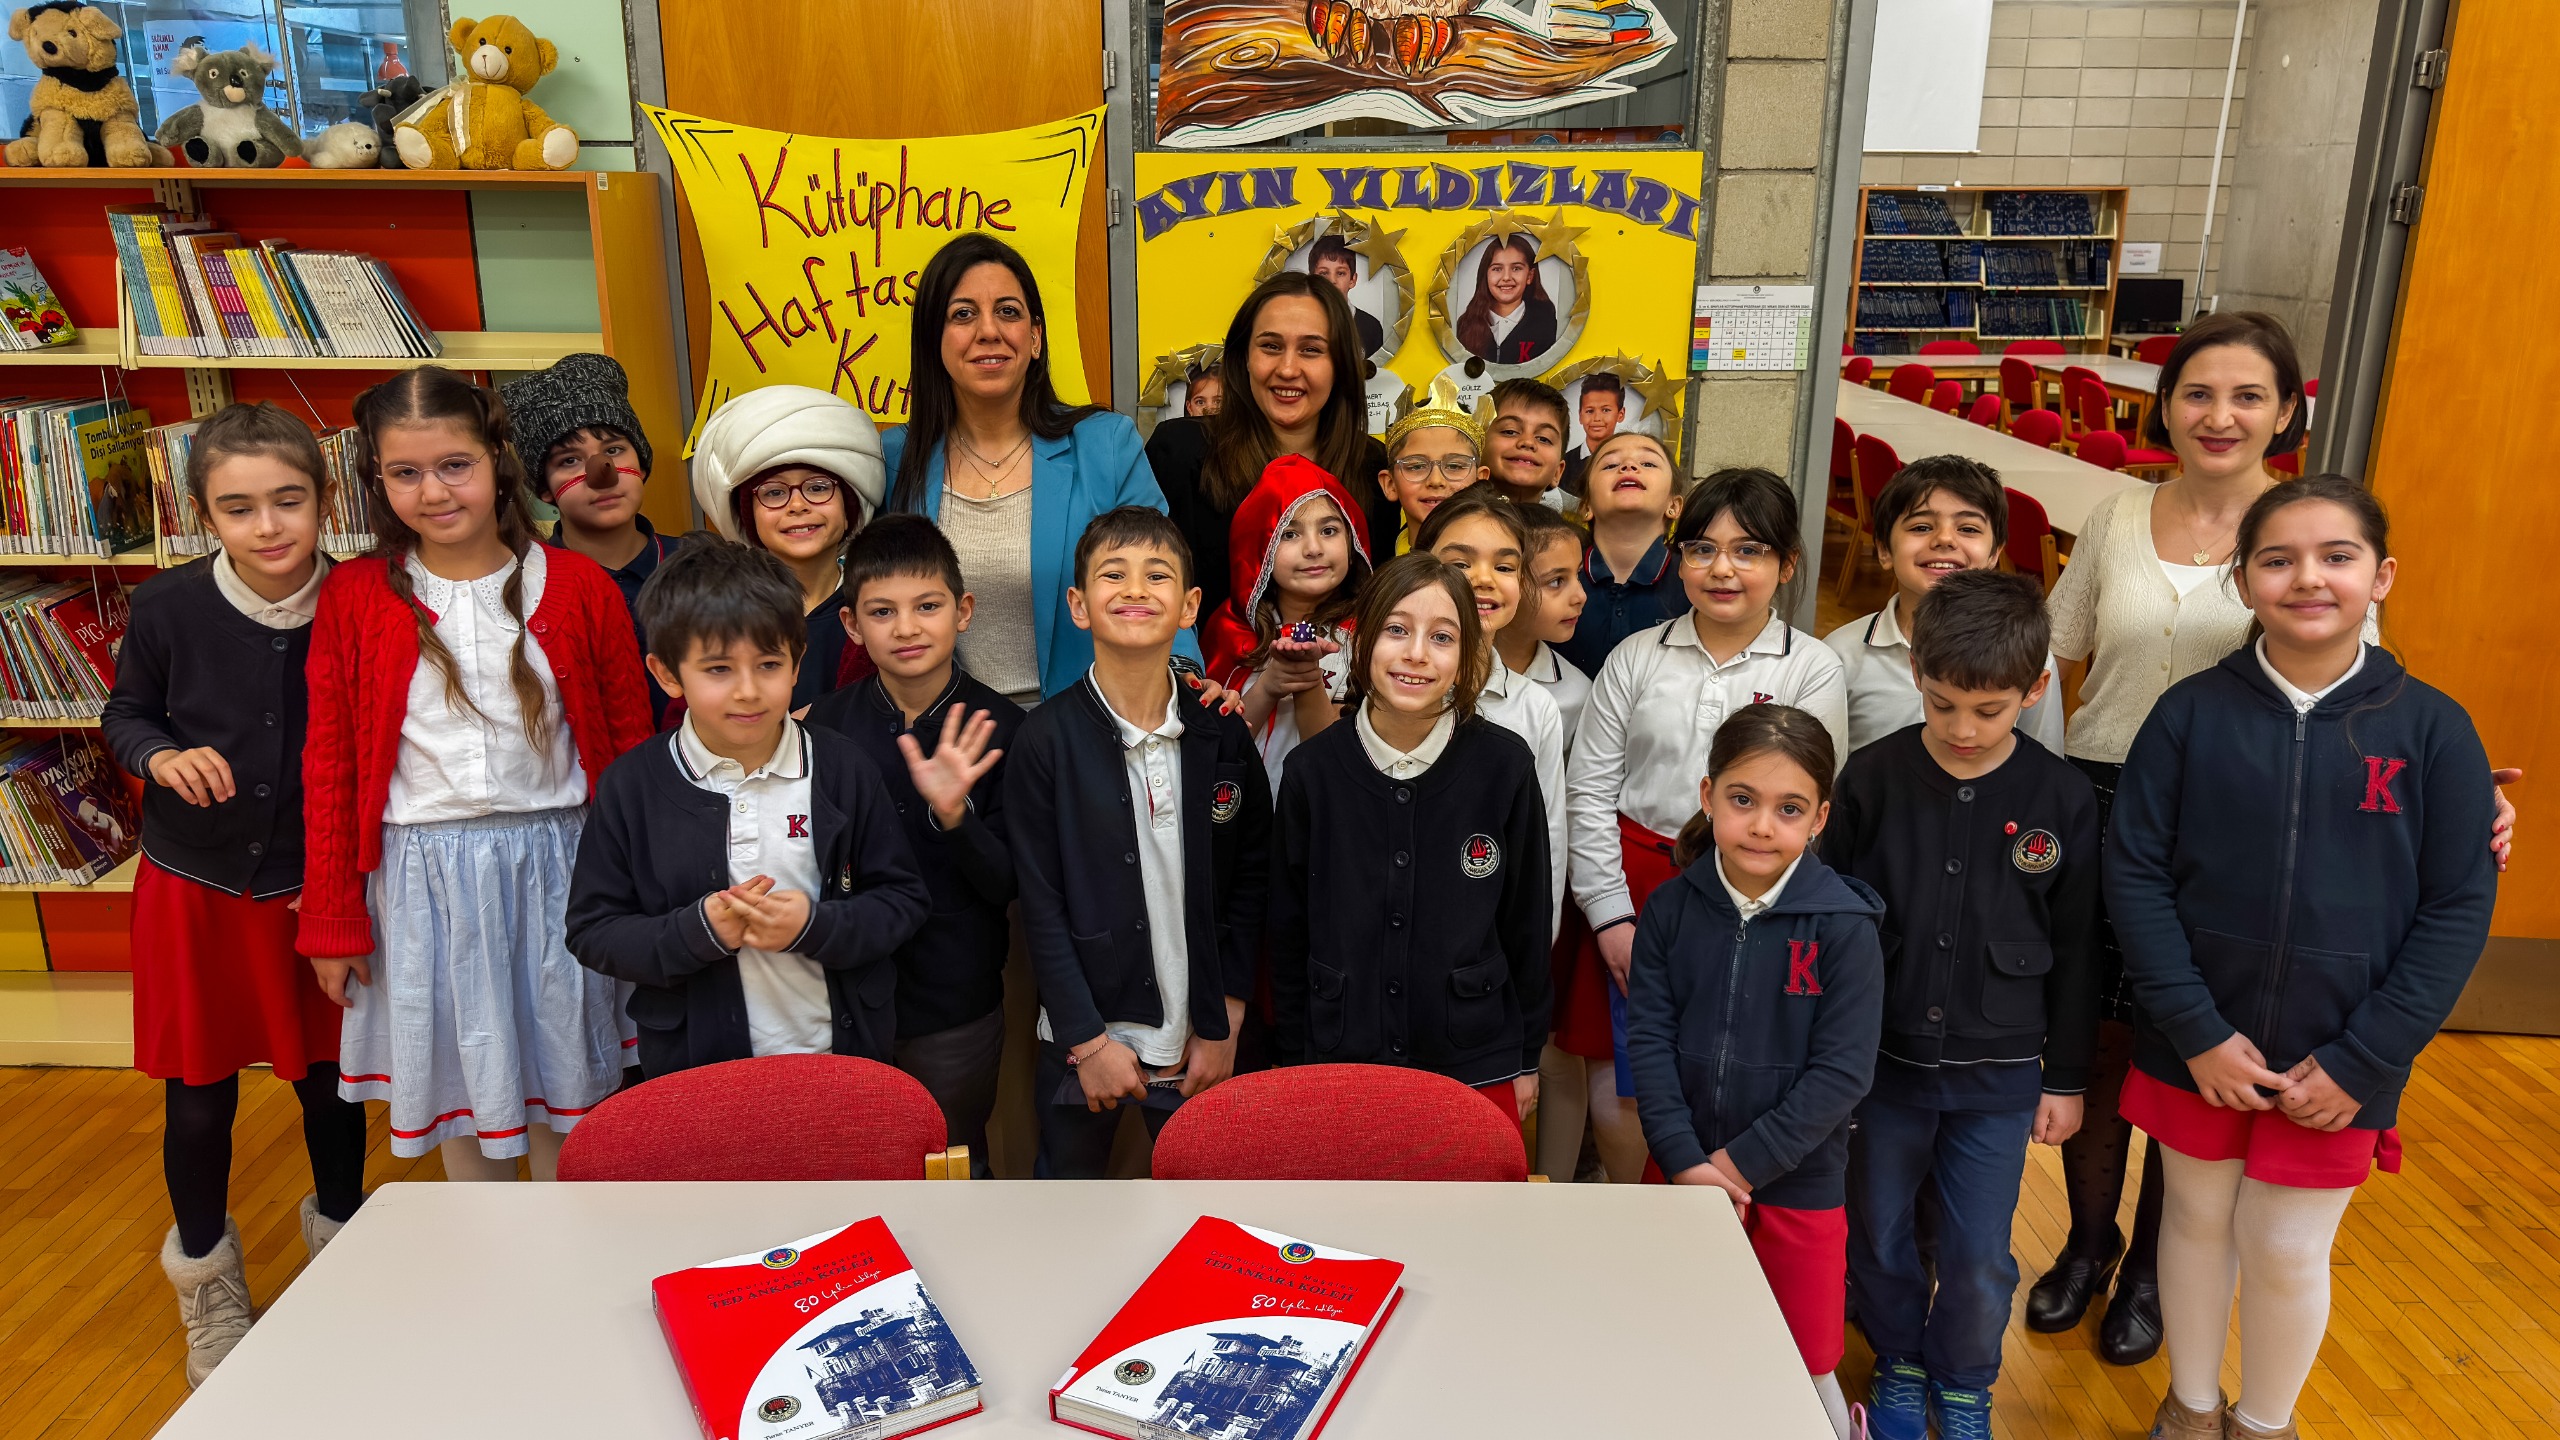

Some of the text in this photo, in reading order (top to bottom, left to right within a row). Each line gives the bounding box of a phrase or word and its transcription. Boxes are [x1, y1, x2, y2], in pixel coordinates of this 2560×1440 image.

[738, 143, 1017, 267] Kütüphane
[1133, 160, 1701, 242] AYIN YILDIZLARI
[718, 251, 918, 374] Haftas
[1518, 341, 1535, 363] K
[2360, 756, 2407, 814] K
[787, 814, 809, 838] K
[1785, 938, 1823, 996] K
[1204, 1257, 1233, 1271] TED
[1234, 1266, 1295, 1288] ANKARA
[710, 1294, 743, 1309] TED
[748, 1276, 815, 1300] ANKARA
[794, 1295, 819, 1313] 80
[1251, 1294, 1277, 1309] 80
[1112, 1390, 1139, 1403] TANYER
[784, 1421, 815, 1434] TANYER
